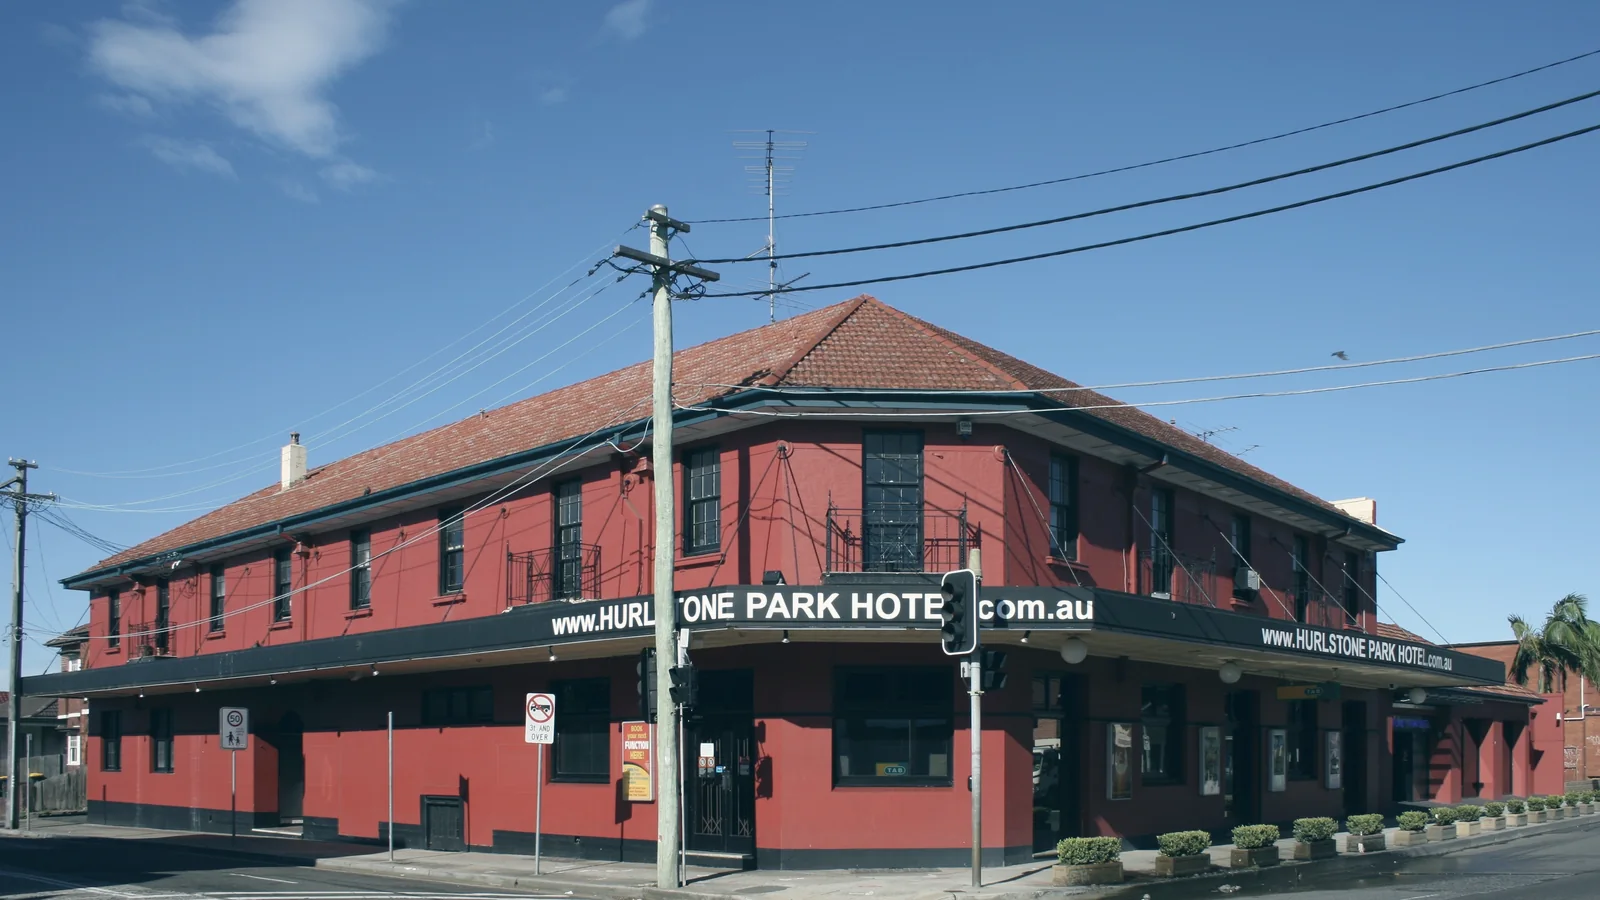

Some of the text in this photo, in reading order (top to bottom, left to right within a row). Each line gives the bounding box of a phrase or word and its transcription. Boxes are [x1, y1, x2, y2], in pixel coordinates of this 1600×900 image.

[552, 592, 735, 635] www.HURLONE
[746, 592, 841, 619] PARK
[1262, 628, 1452, 670] www.HURLSTONE PARK HOTEL.com.au
[230, 715, 240, 723] 50
[531, 733, 549, 741] OVER
[625, 741, 649, 750] FUNCTION
